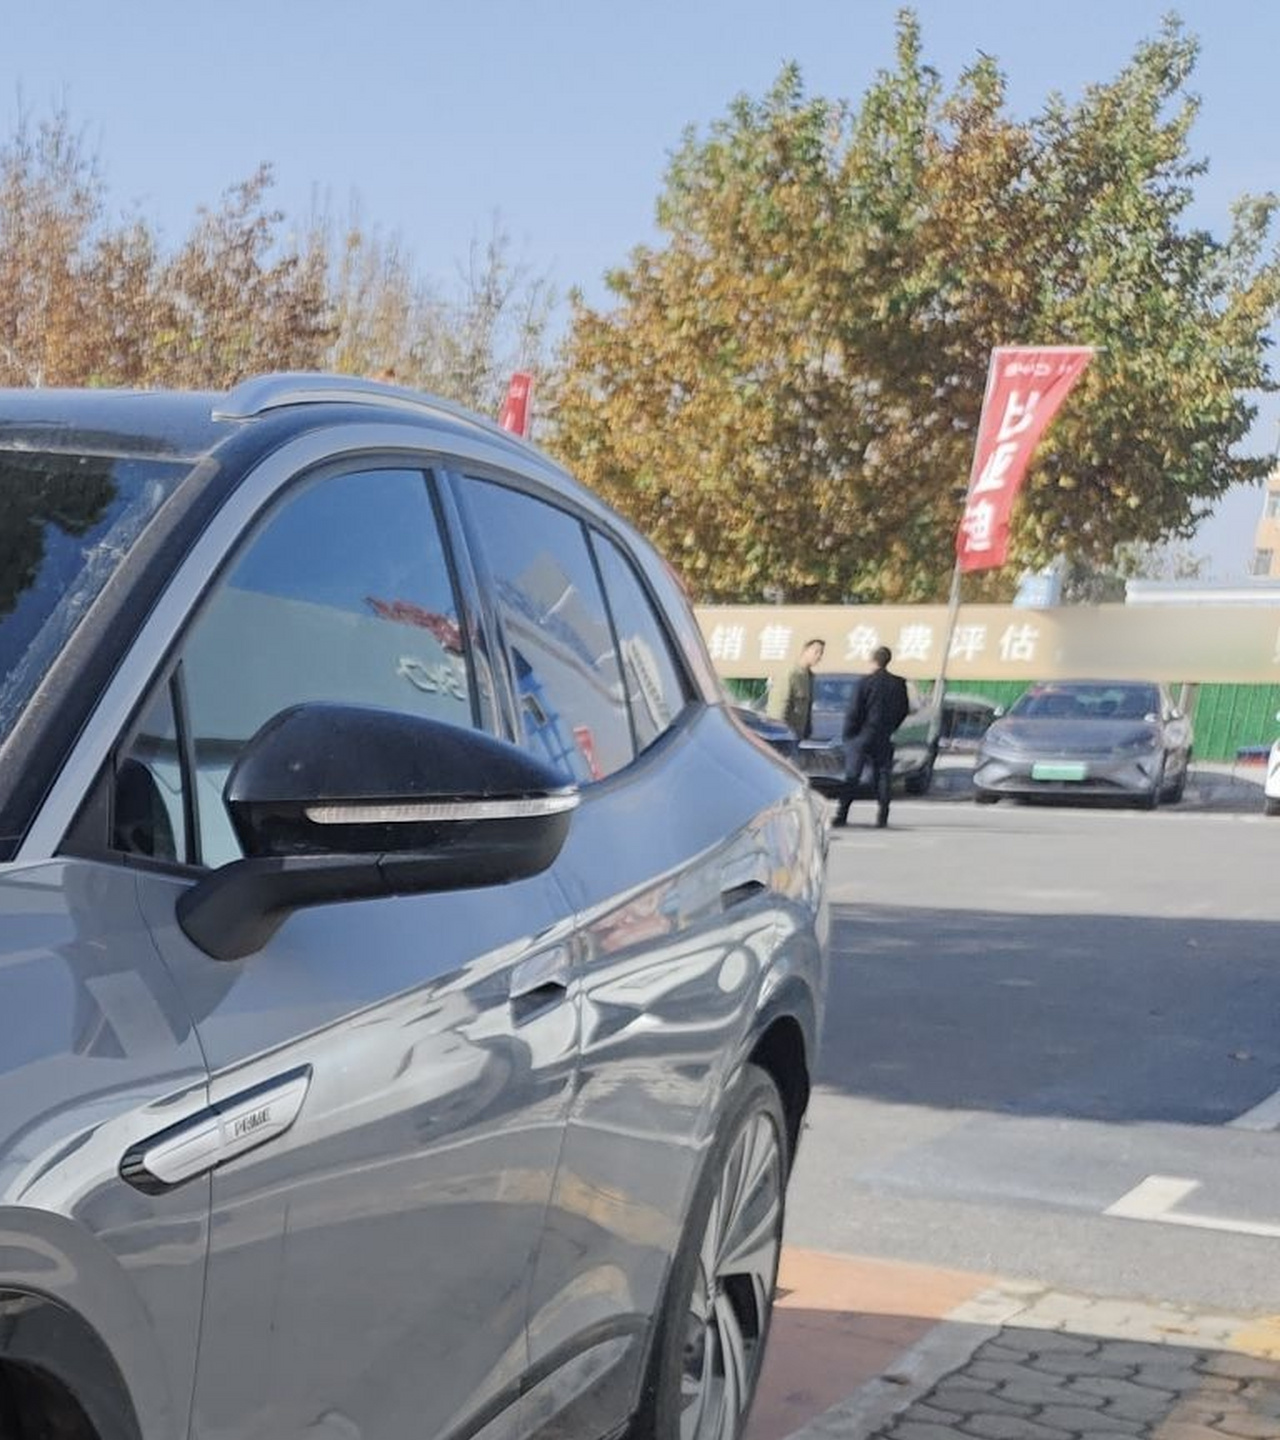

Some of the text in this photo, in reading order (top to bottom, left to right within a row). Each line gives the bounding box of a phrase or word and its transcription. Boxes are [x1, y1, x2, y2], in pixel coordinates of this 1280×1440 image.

[708, 623, 1040, 662] 销售 免费评估
